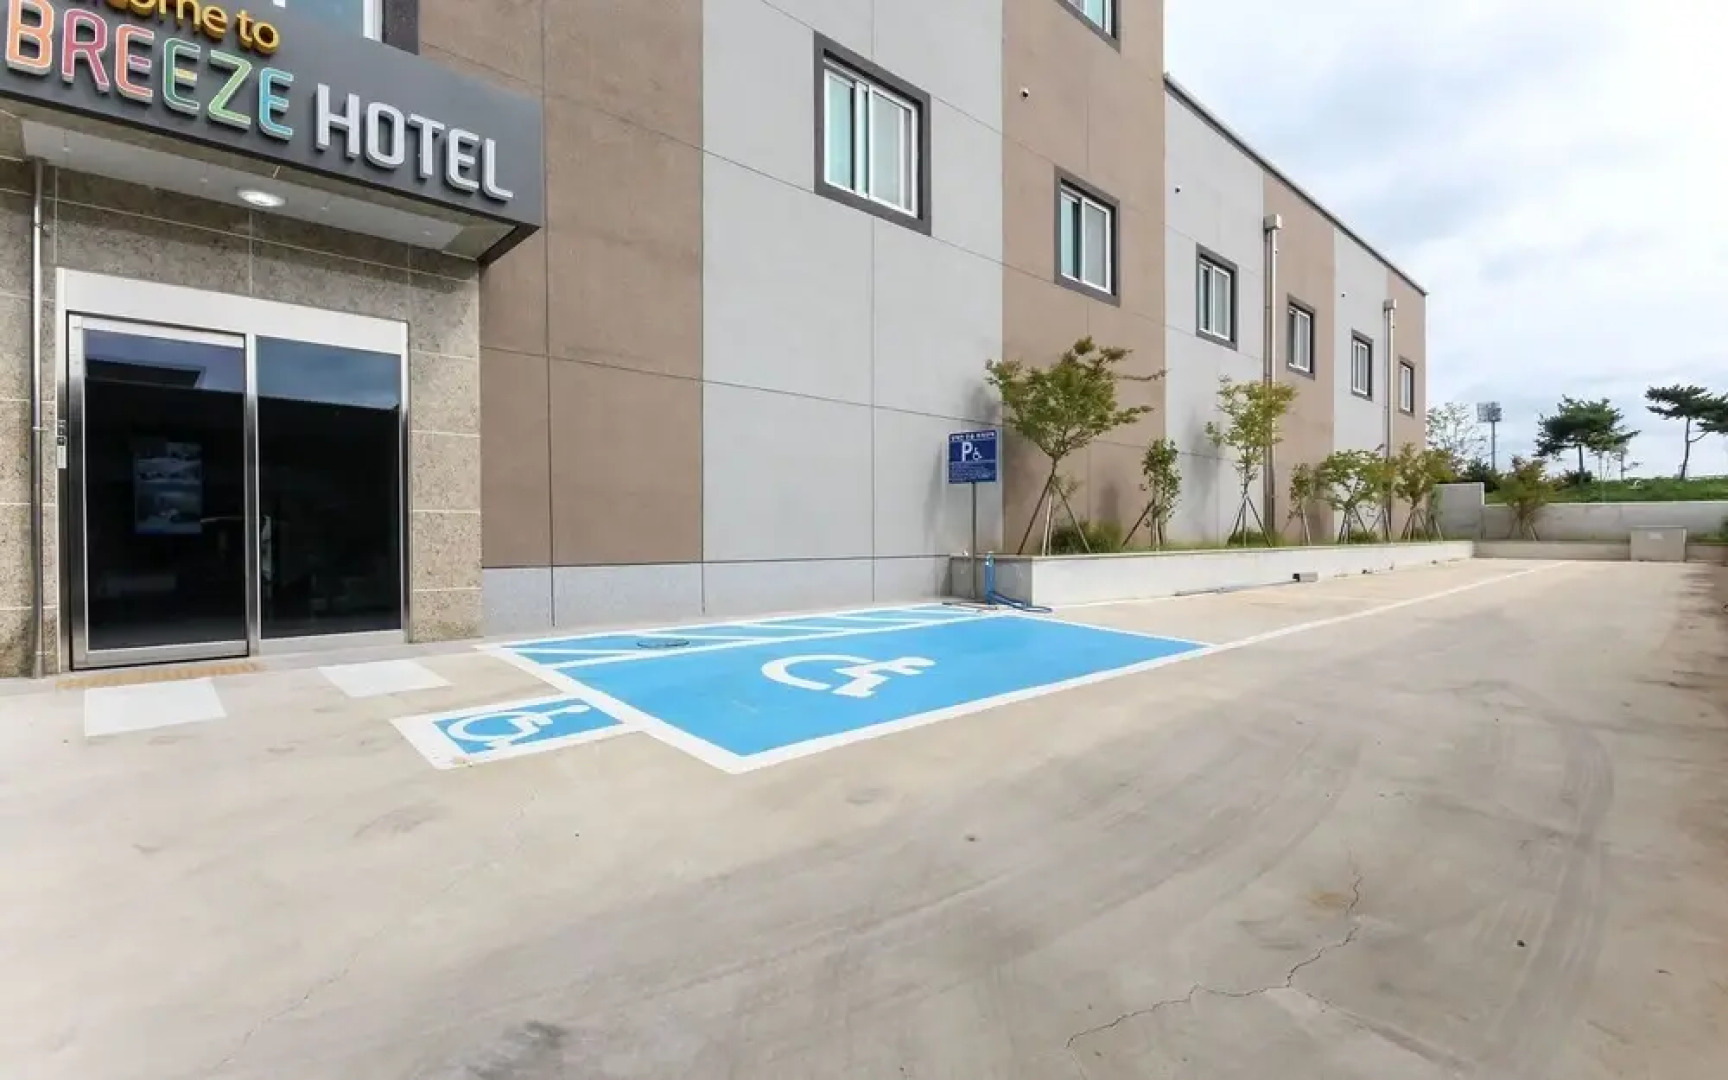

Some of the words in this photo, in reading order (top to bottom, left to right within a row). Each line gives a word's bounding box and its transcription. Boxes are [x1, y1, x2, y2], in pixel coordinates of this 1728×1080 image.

[236, 9, 280, 54] to
[5, 0, 294, 141] BREEZE
[316, 83, 513, 200] HOTEL
[962, 441, 973, 461] P
